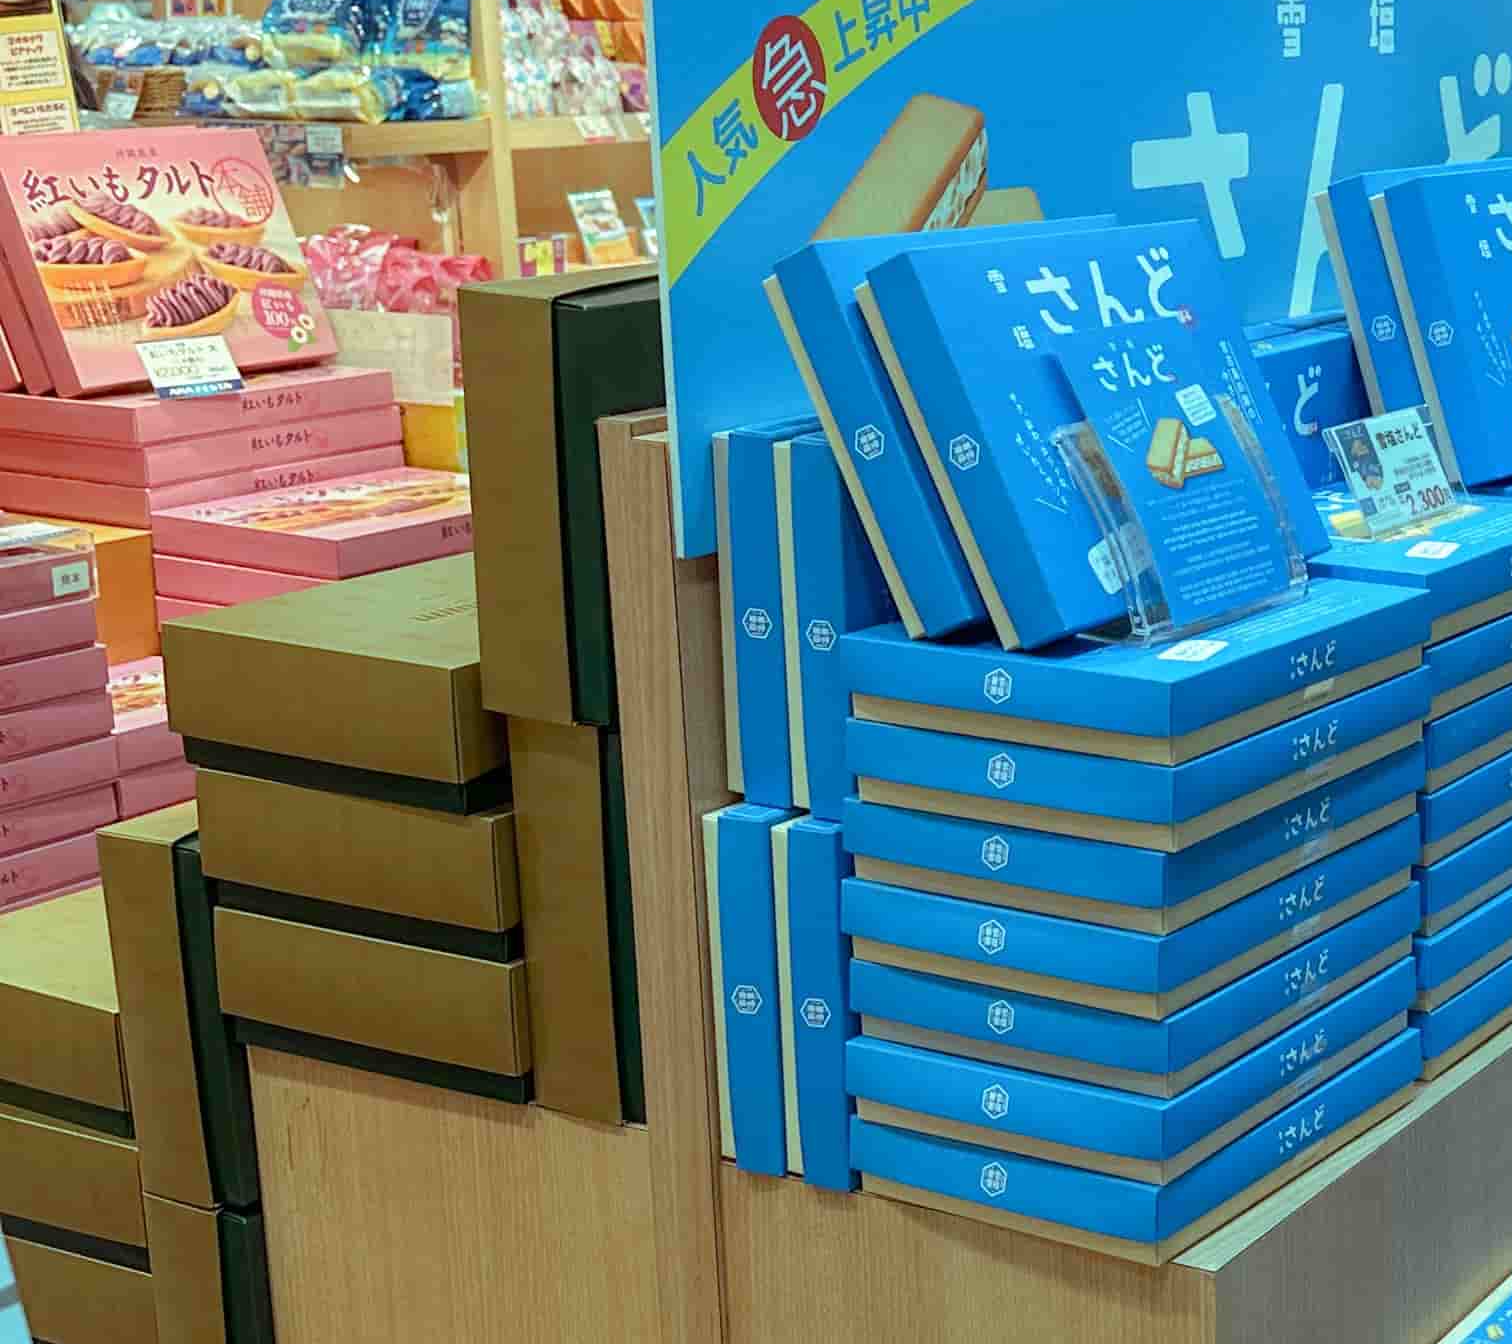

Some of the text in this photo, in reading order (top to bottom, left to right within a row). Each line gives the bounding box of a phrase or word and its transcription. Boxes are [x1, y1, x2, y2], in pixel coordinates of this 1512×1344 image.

[22, 160, 215, 213] 紅いもタルト
[1025, 246, 1187, 334] さんど
[1092, 343, 1180, 392] さんど
[242, 391, 303, 410] 紅いもタルト
[251, 428, 313, 449] 紅いもタルト
